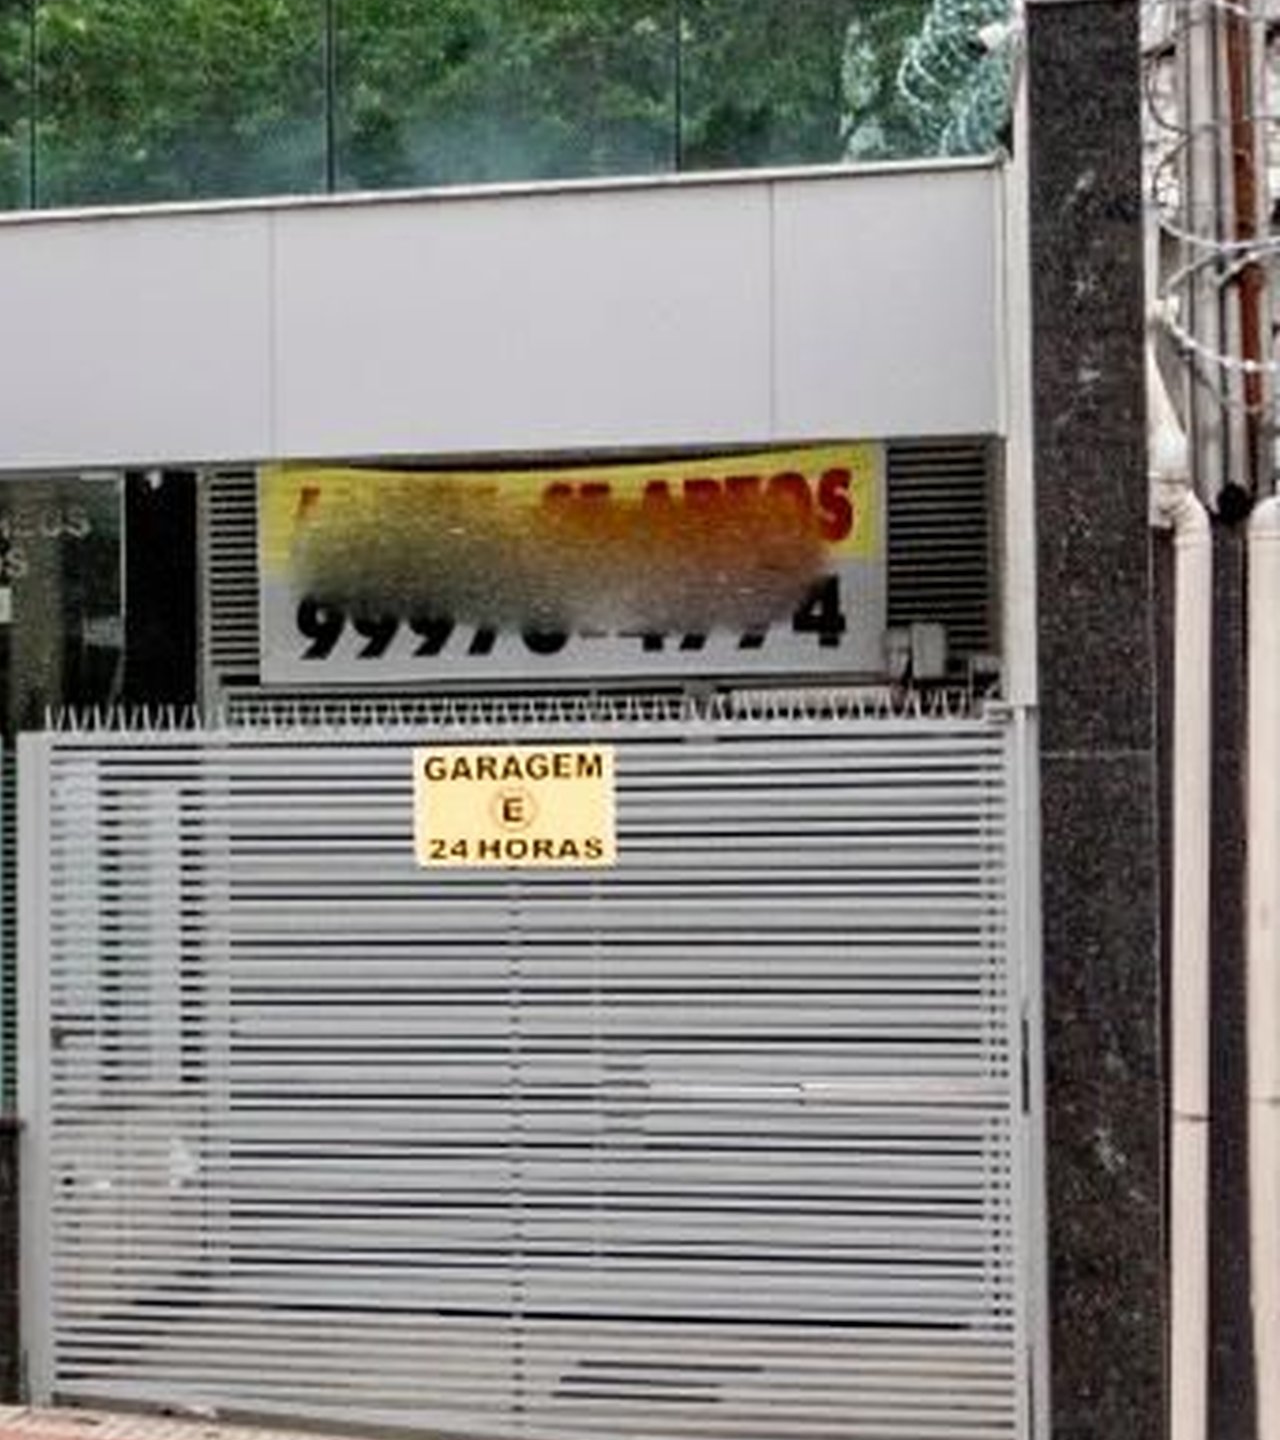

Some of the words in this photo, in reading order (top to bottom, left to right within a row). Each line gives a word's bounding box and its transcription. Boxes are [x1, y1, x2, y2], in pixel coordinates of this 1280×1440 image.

[423, 752, 604, 782] GARAGEM
[502, 796, 525, 823] E
[429, 838, 469, 860] 24
[477, 836, 605, 860] HORAS
